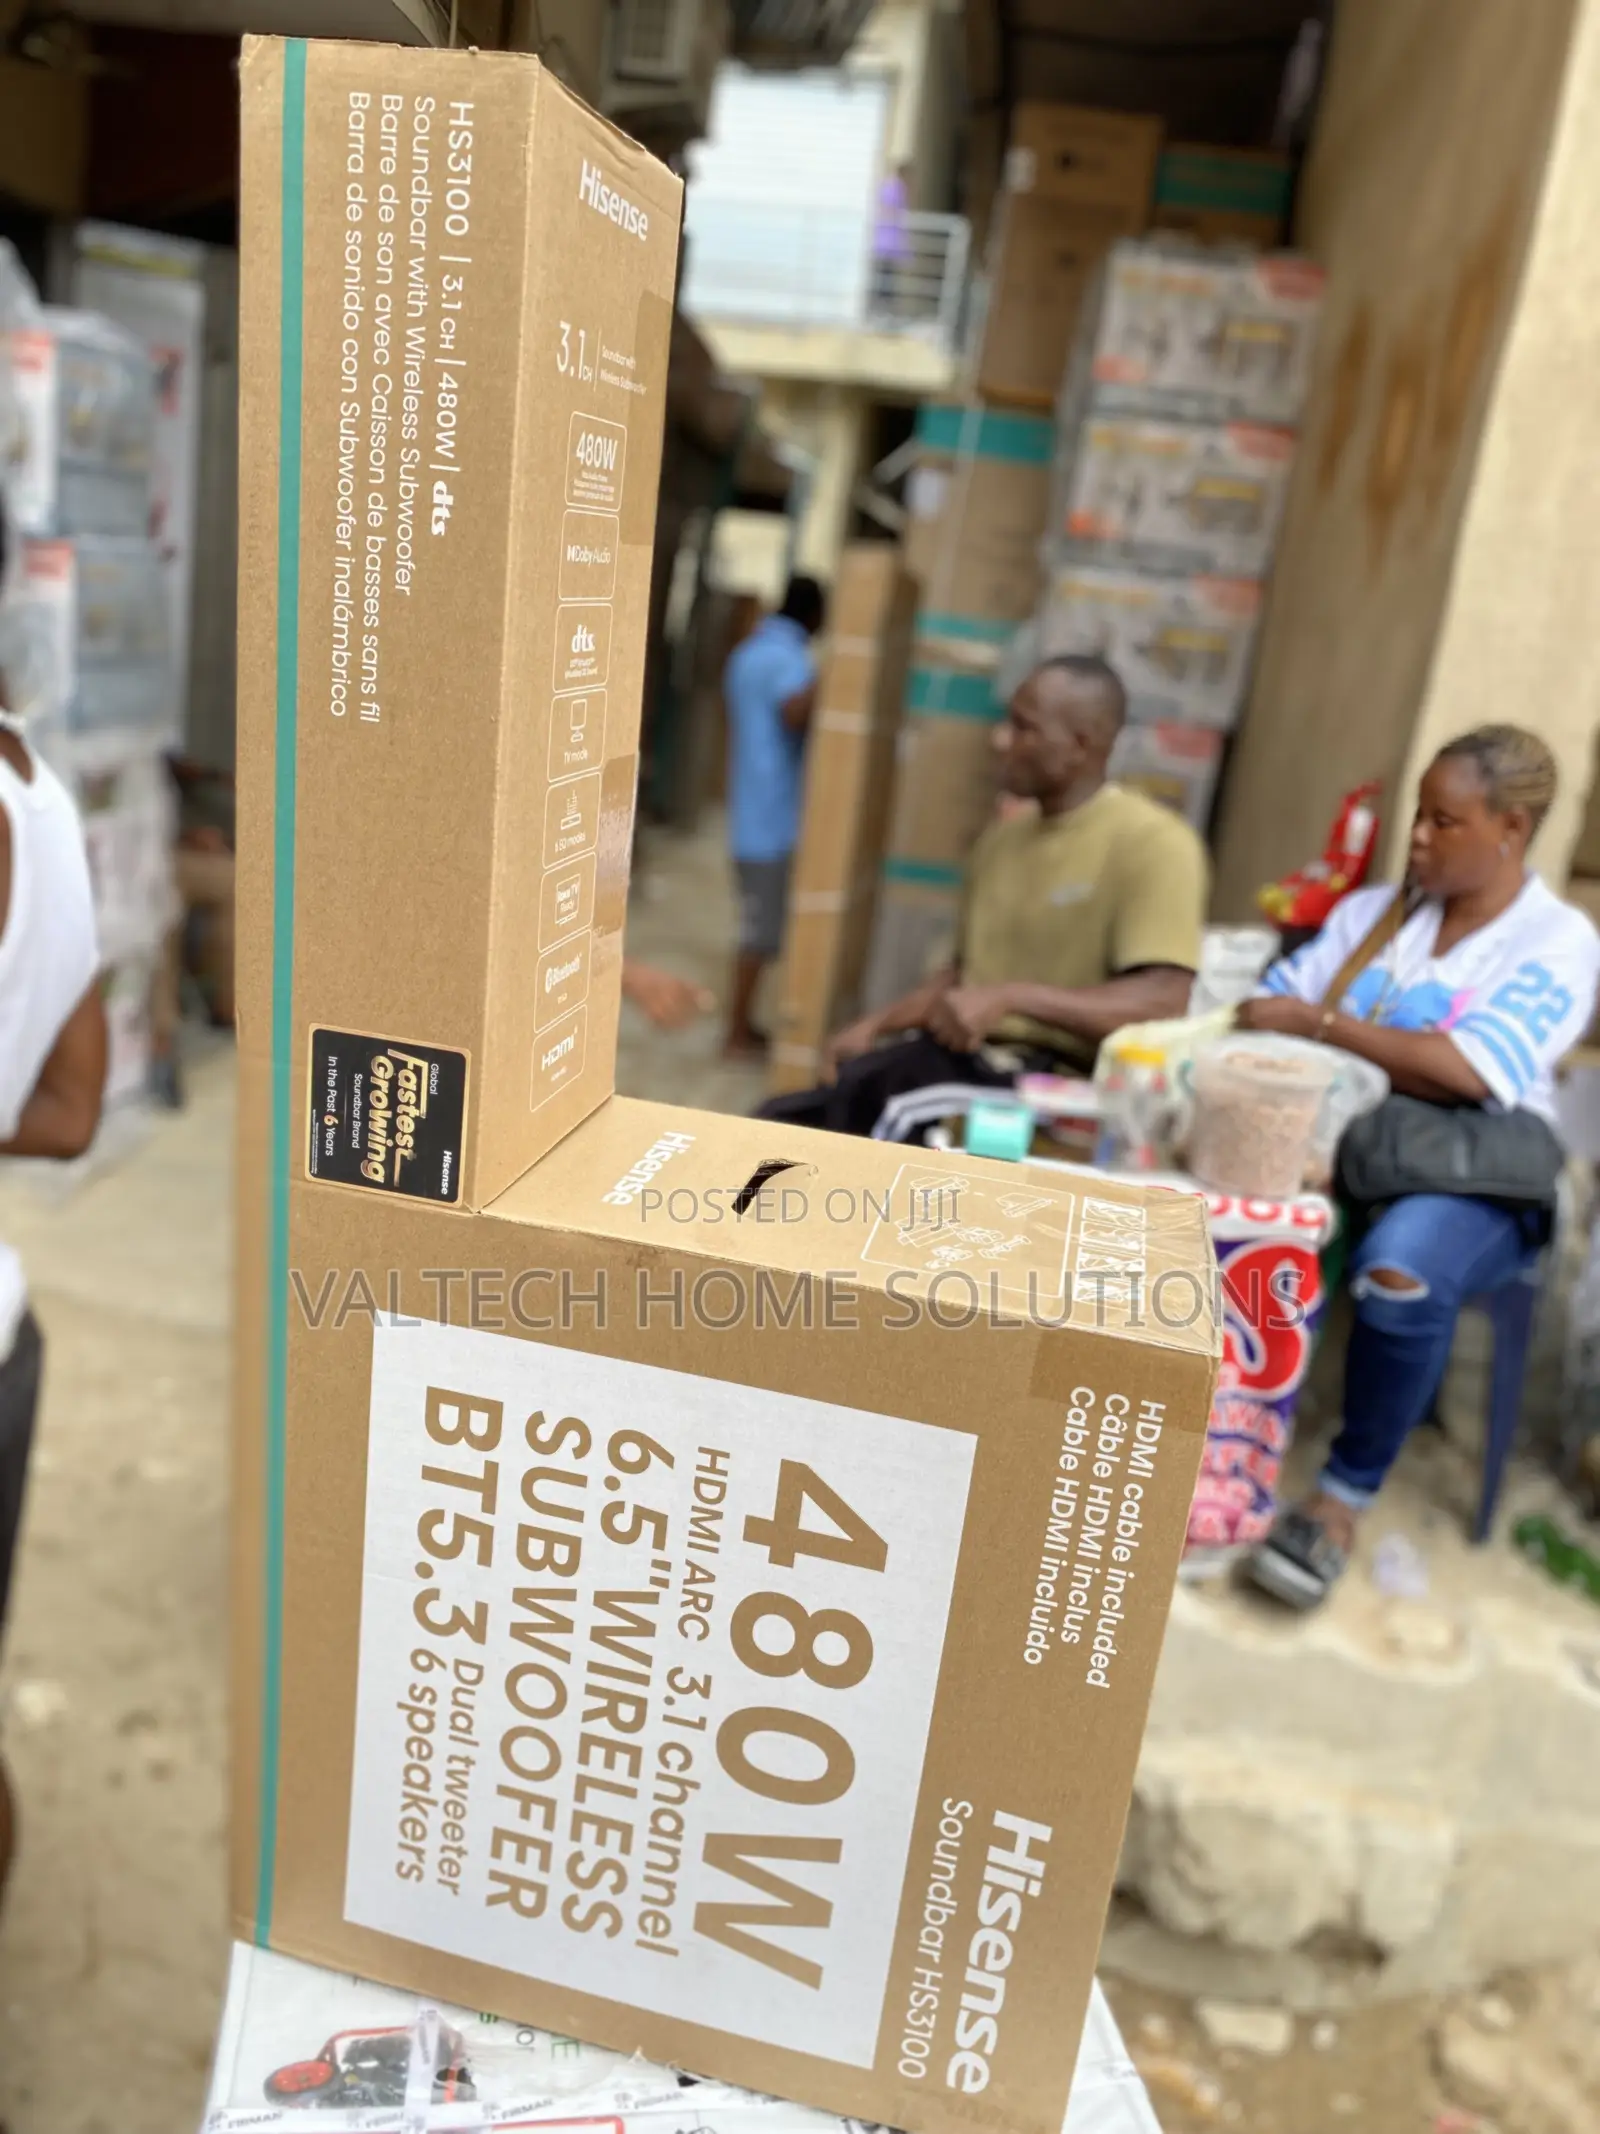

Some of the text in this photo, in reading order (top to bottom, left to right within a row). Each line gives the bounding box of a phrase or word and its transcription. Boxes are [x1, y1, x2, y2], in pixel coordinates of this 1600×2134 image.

[431, 101, 475, 536] HS3100 3.1 CH 480W dts
[579, 159, 649, 241] Hisense
[330, 92, 371, 717] Barra de sonido con Subwoofer inalámbrico
[359, 94, 404, 723] Barre de son avec Caisson de basses sans fil
[395, 95, 436, 596] Soundbar with Wireless Subwoofer
[575, 431, 618, 471] 480W
[571, 624, 595, 653] dts
[323, 1056, 339, 1157] In the Past 6 Years
[351, 1073, 363, 1149] Soundbar Brand
[388, 1048, 429, 1172] Fastest
[429, 1063, 439, 1095] Global
[440, 1150, 452, 1195] Hisense
[601, 1131, 697, 1206] Hisense
[413, 1385, 504, 1896] BT5.3 Dual tweeter
[1023, 1386, 1096, 1665] Cable HDMI incluido
[1060, 1393, 1130, 1645] Câble HDMI inclus
[1085, 1399, 1166, 1688] HDMI cable included
[396, 1648, 447, 1883] 6 speakers
[485, 1410, 592, 1919] SUBWOOFER
[634, 1446, 730, 1957] HDMI ARC 3.1 channel
[693, 1458, 889, 1992] 480W
[897, 1797, 974, 2079] Soundbar HS3100
[945, 1809, 1053, 2094] Hisense
